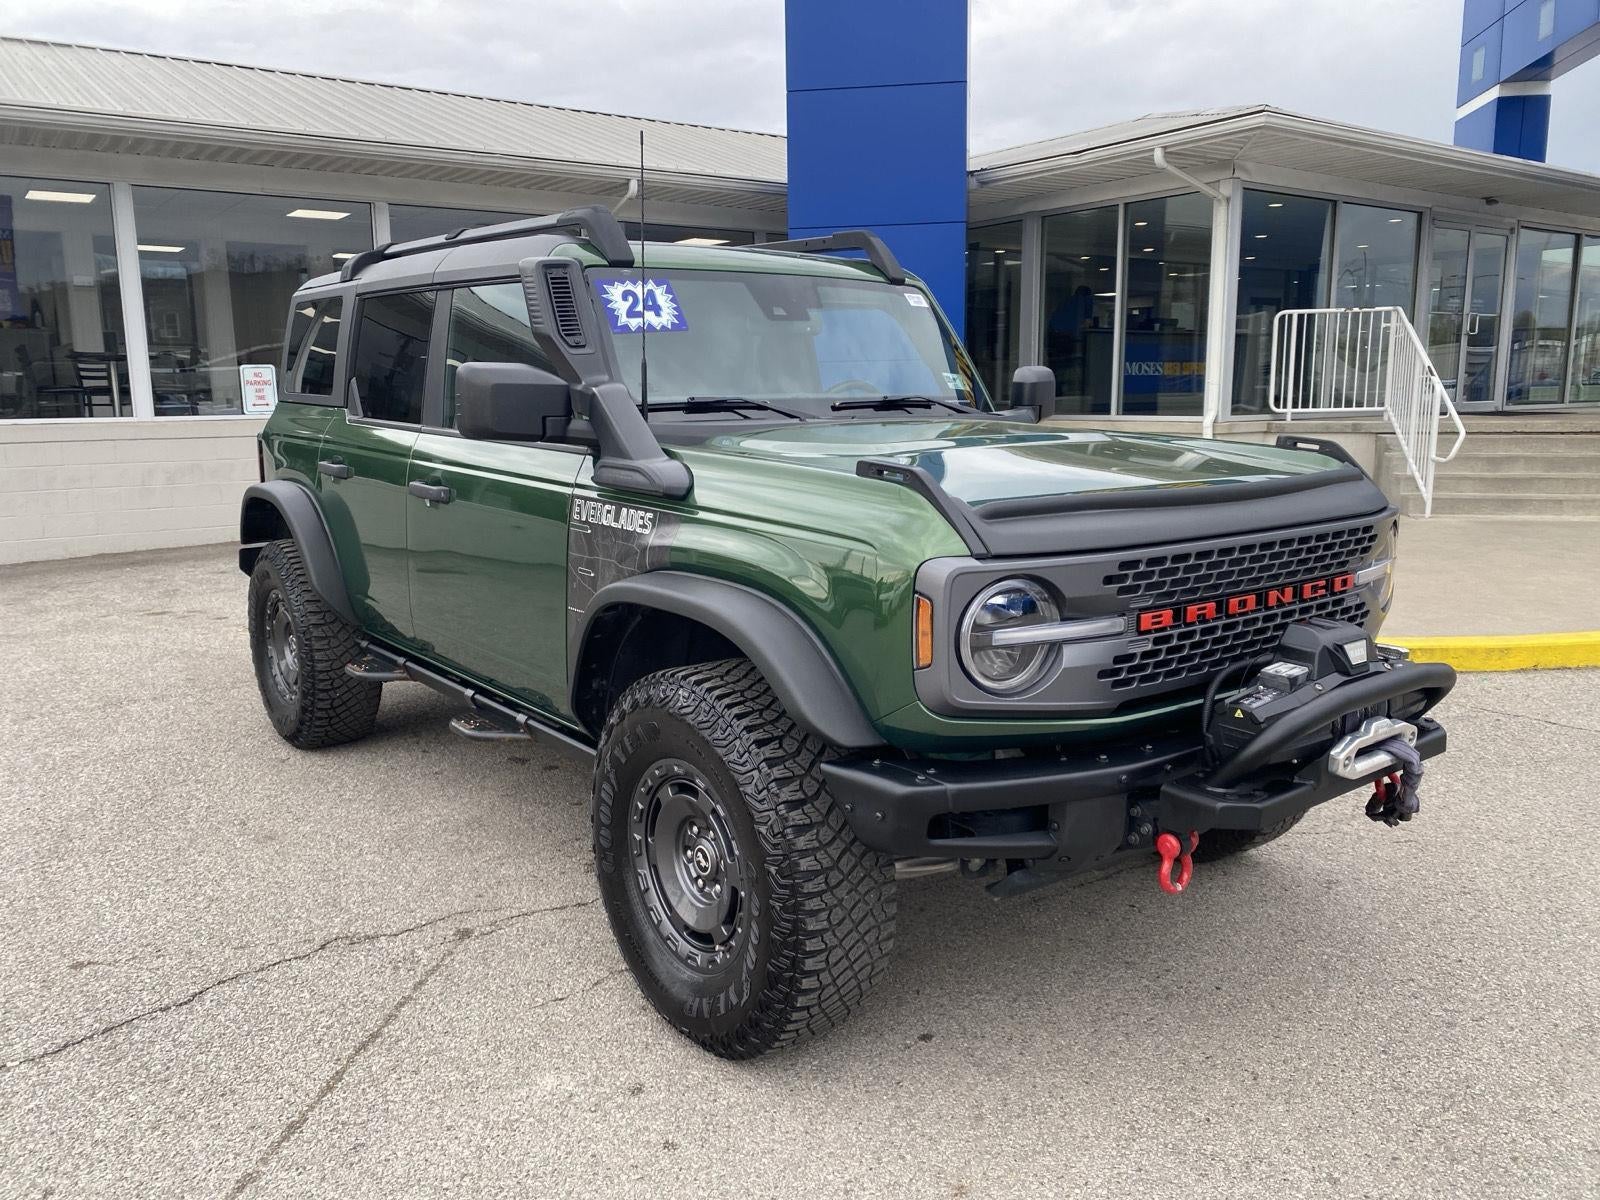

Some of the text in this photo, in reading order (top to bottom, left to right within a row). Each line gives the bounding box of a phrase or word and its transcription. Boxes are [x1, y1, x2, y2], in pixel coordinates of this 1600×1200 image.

[621, 288, 663, 319] 24
[1125, 361, 1163, 376] MOSES
[572, 498, 654, 535] EVERGLADES
[1139, 573, 1356, 632] BRONCO
